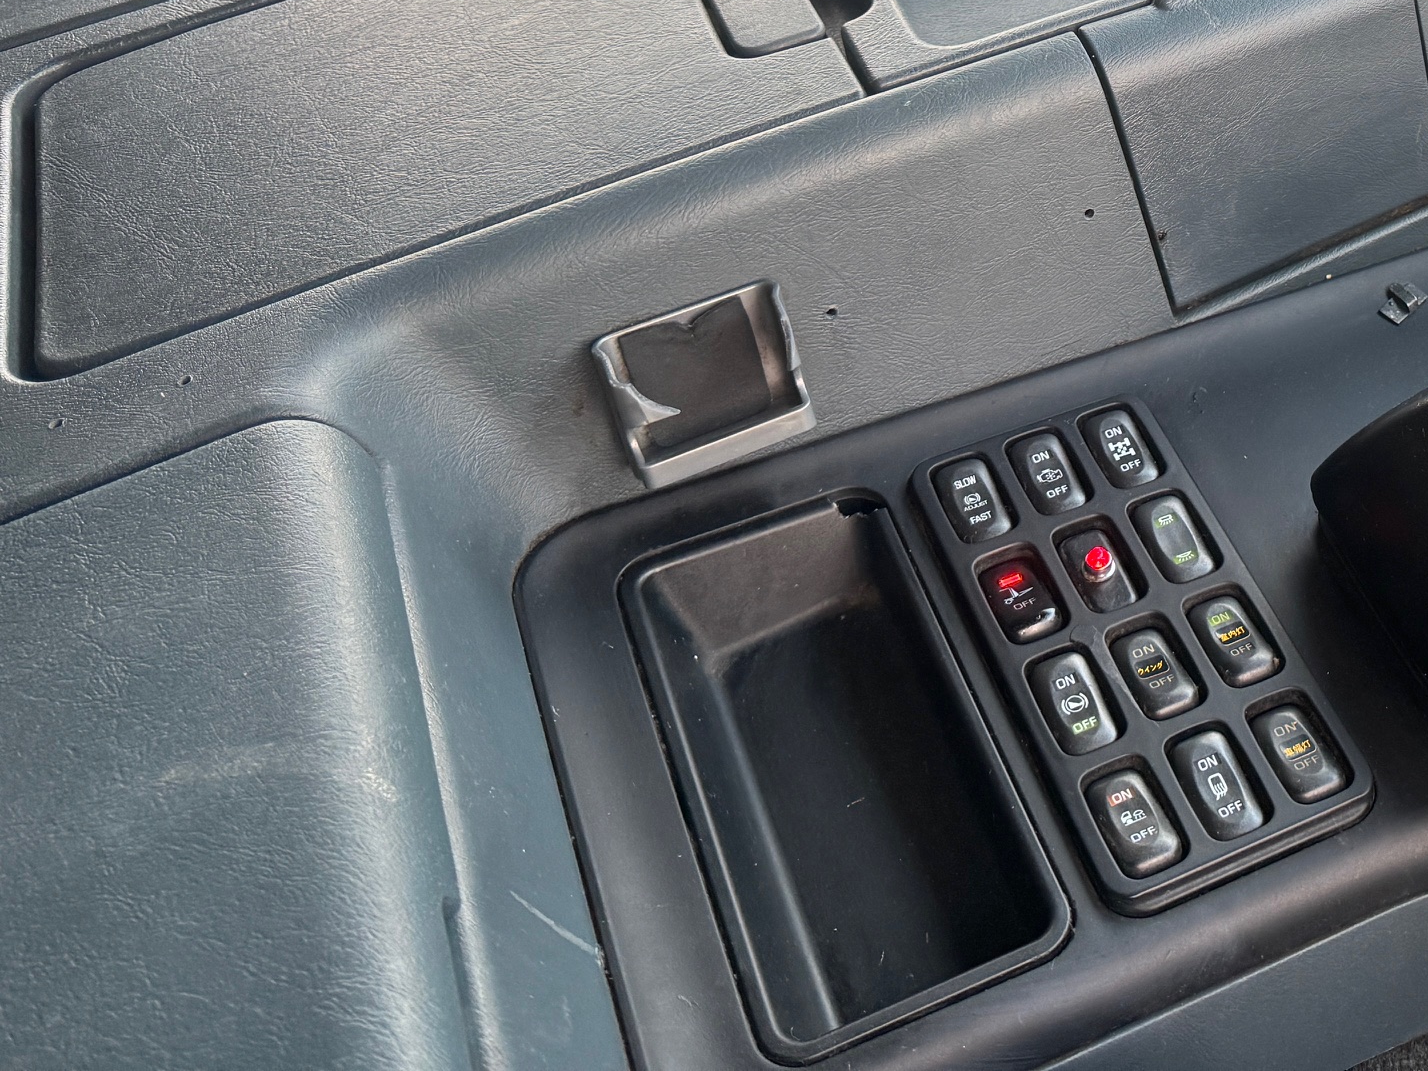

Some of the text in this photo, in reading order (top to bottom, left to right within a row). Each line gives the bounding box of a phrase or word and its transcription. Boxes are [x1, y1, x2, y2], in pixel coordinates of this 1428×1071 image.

[1104, 425, 1123, 439] ON
[1031, 450, 1050, 464] ON
[1120, 458, 1142, 473] OFF
[953, 474, 977, 490] SLOW
[1046, 484, 1069, 499] OFF
[963, 499, 988, 512] ADJUST
[969, 510, 993, 525] FAST
[1013, 597, 1036, 610] OFF
[1211, 611, 1230, 625] ON
[1132, 643, 1155, 659] ON
[1230, 642, 1253, 656] OFF
[1055, 674, 1076, 690] ON
[1148, 674, 1175, 690] OFF
[1072, 716, 1098, 734] OFF
[1273, 721, 1298, 737] ON
[1197, 754, 1219, 772] ON
[1294, 754, 1320, 770] OFF
[1111, 788, 1133, 804] ON
[1216, 800, 1243, 819] OFF
[1130, 825, 1156, 845] OFF
